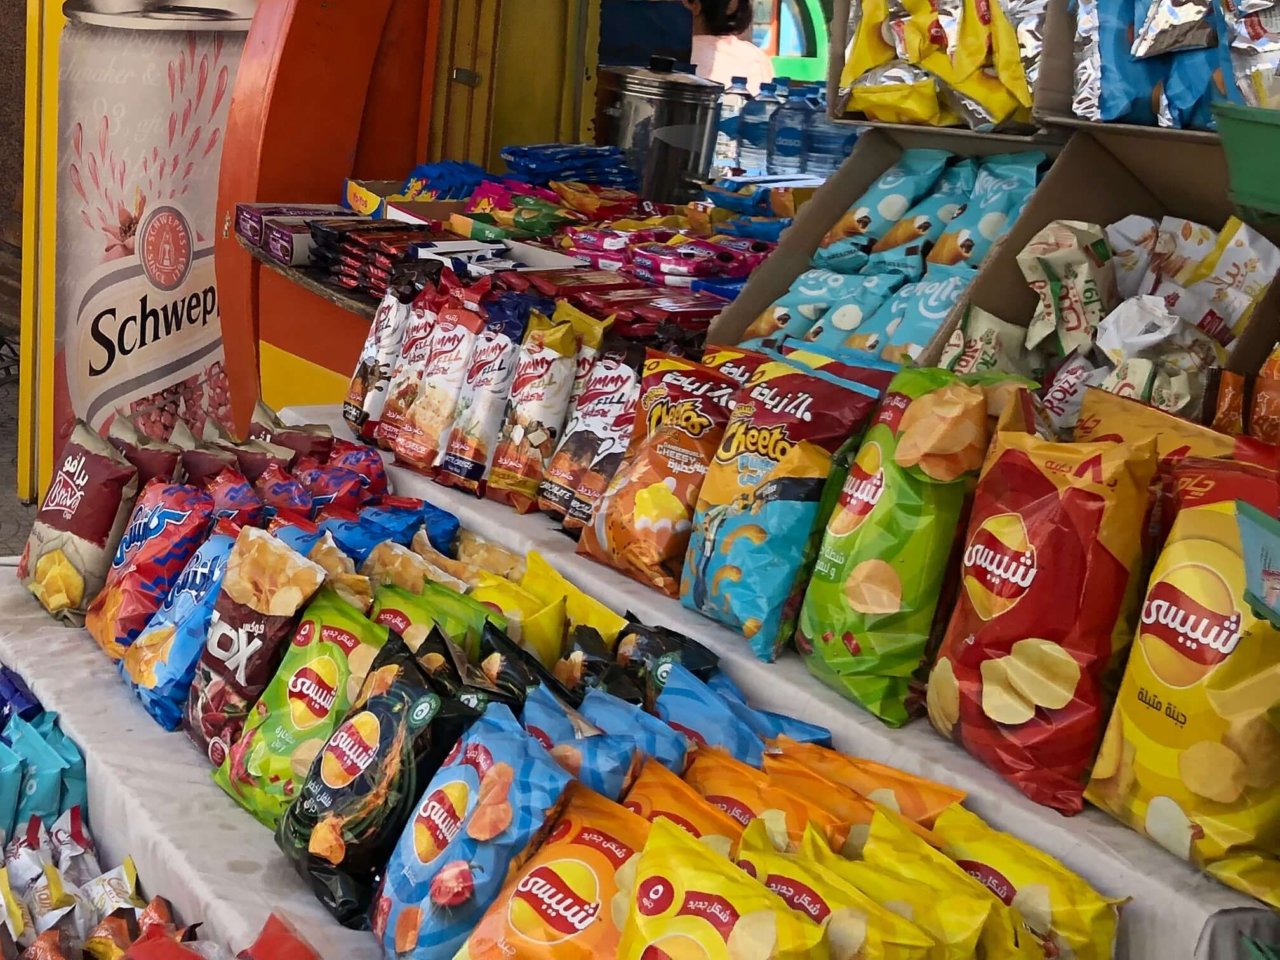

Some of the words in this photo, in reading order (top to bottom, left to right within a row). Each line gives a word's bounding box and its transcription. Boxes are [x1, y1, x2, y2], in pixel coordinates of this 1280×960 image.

[89, 283, 220, 377] Schwep
[716, 418, 794, 463] Cheeto
[206, 609, 264, 687] OX
[1136, 686, 1163, 713] متبلة
[1165, 703, 1188, 729] جبنة
[686, 898, 709, 913] جديد
[706, 901, 732, 924] شكل
[792, 893, 821, 917] شكل
